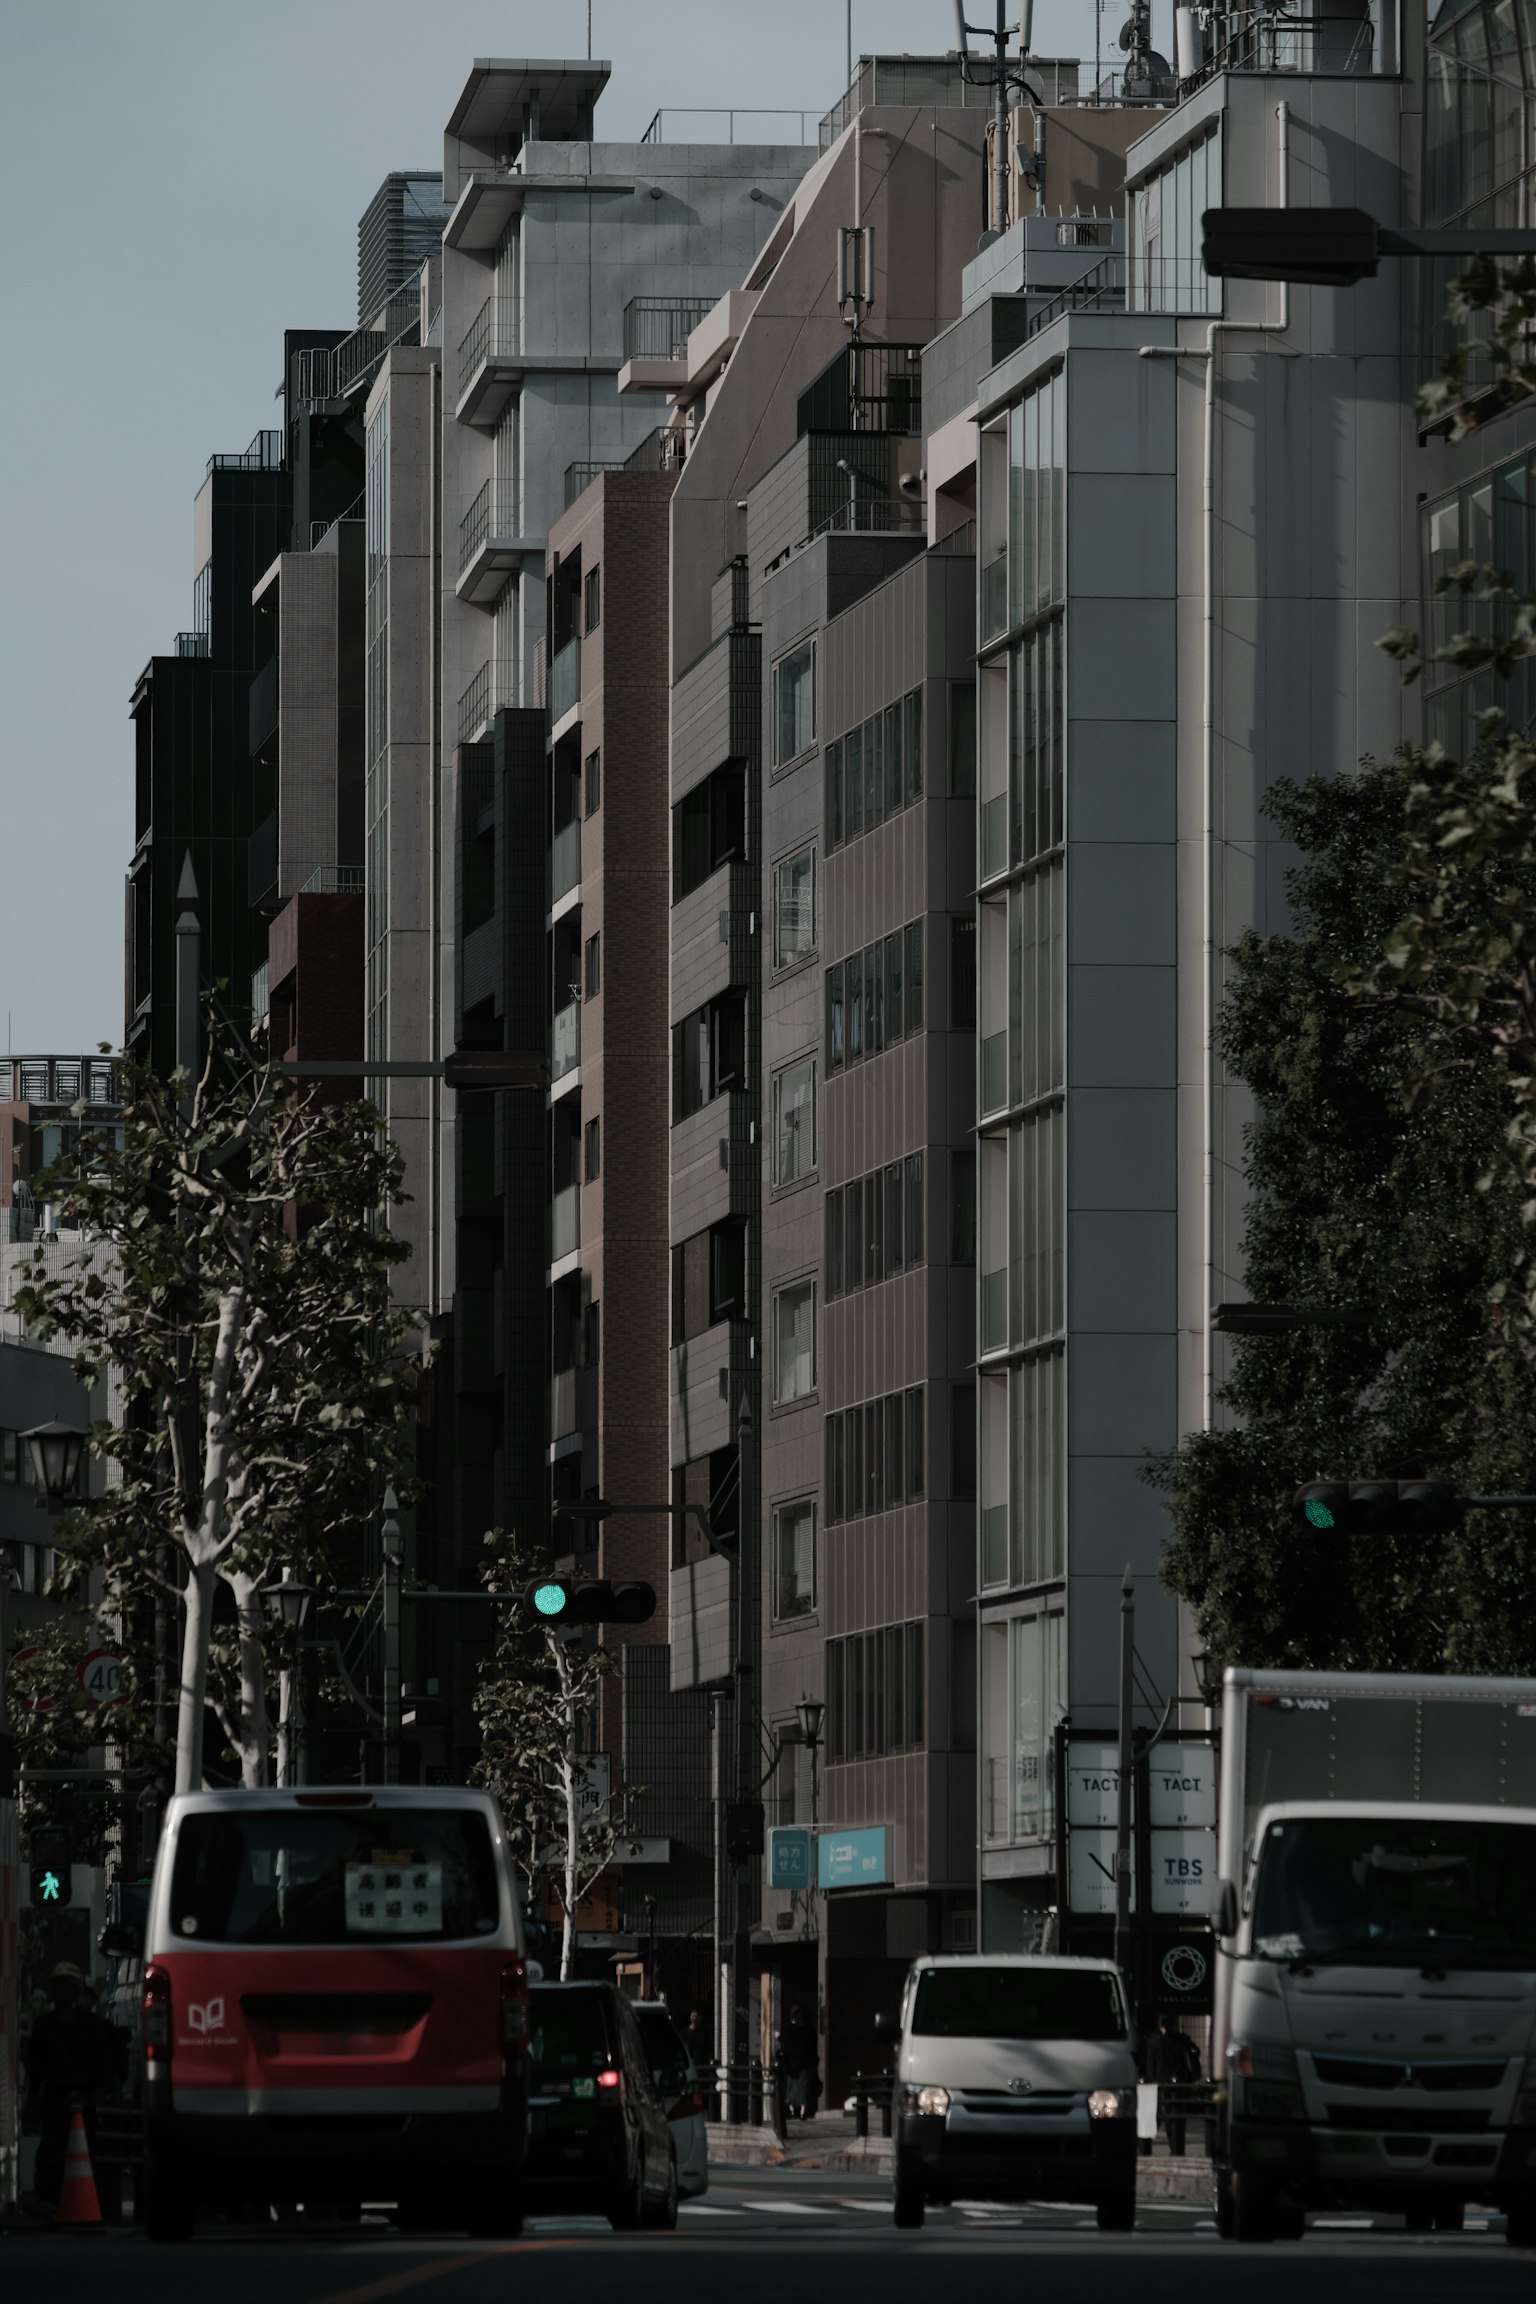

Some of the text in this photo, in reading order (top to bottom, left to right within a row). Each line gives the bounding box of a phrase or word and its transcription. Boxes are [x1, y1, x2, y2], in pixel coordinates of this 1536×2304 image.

[1082, 1778, 1119, 1791] TACT
[1163, 1778, 1201, 1791] TACT
[778, 1847, 801, 1858] 処方
[779, 1861, 801, 1871] せん
[1164, 1859, 1203, 1876] TBS
[1164, 1878, 1203, 1886] SUNWORK
[359, 1901, 428, 1918] 送迎中
